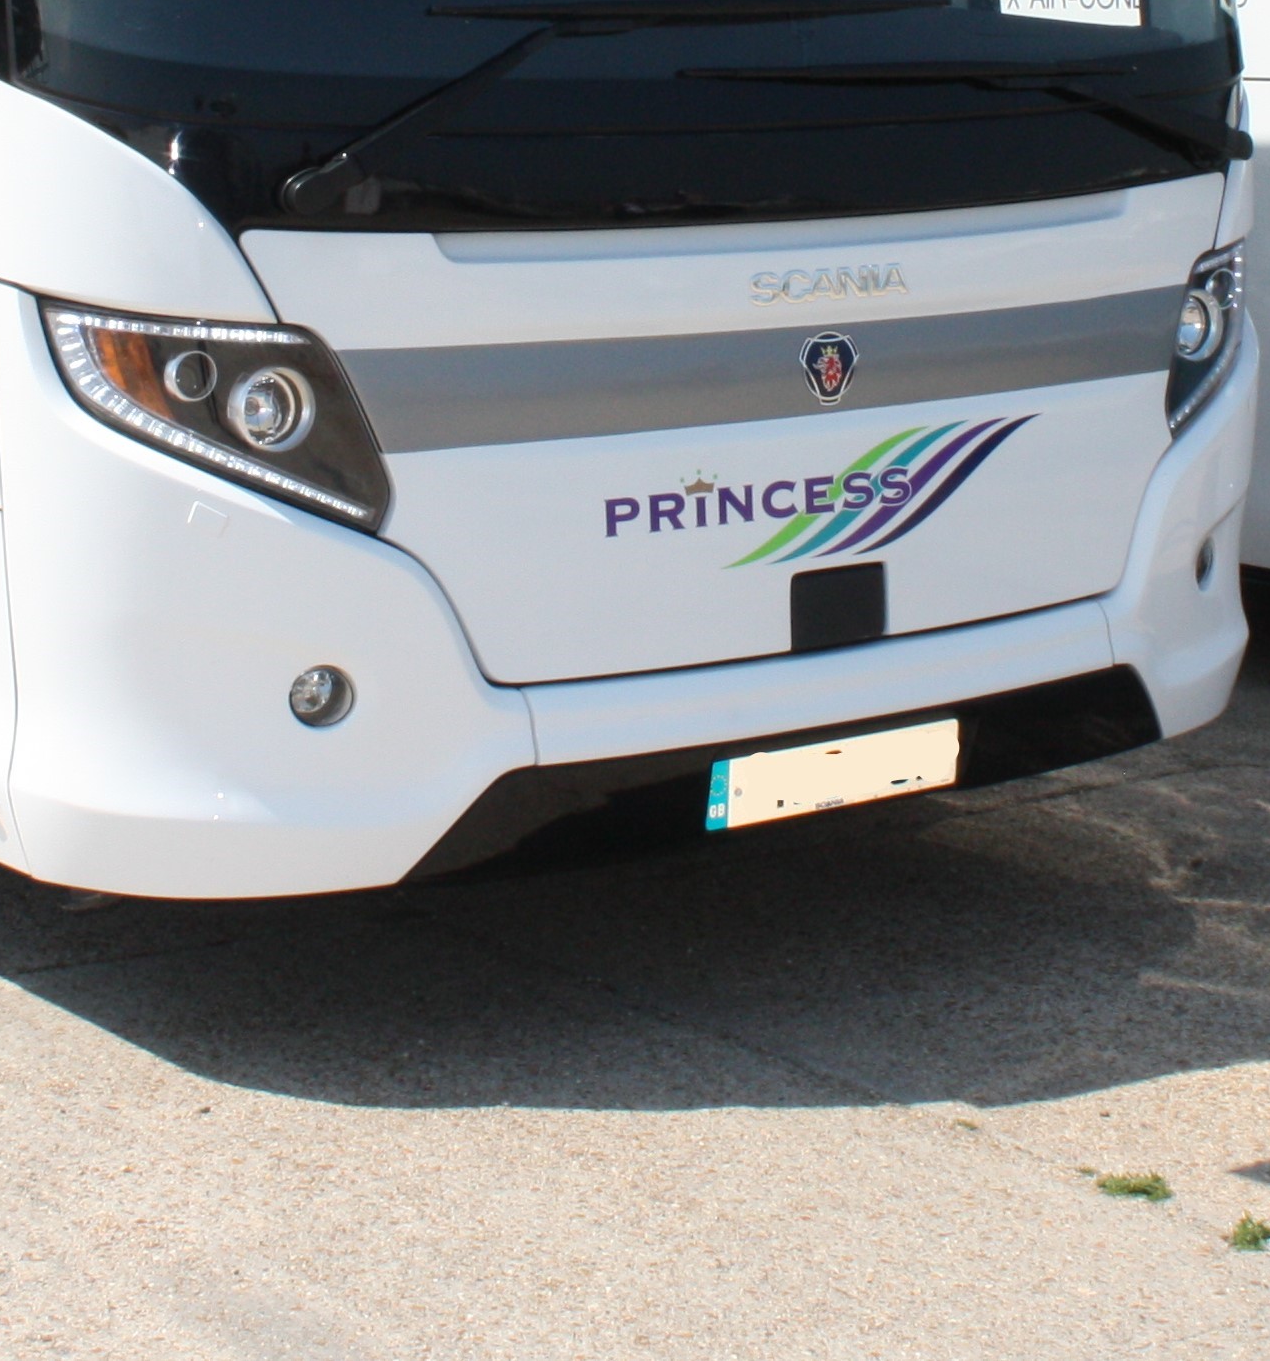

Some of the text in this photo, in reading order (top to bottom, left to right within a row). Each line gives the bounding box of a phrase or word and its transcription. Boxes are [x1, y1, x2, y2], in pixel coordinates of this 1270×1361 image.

[749, 262, 909, 308] SCANIA
[605, 467, 913, 538] PRINCESS
[709, 803, 726, 818] GB
